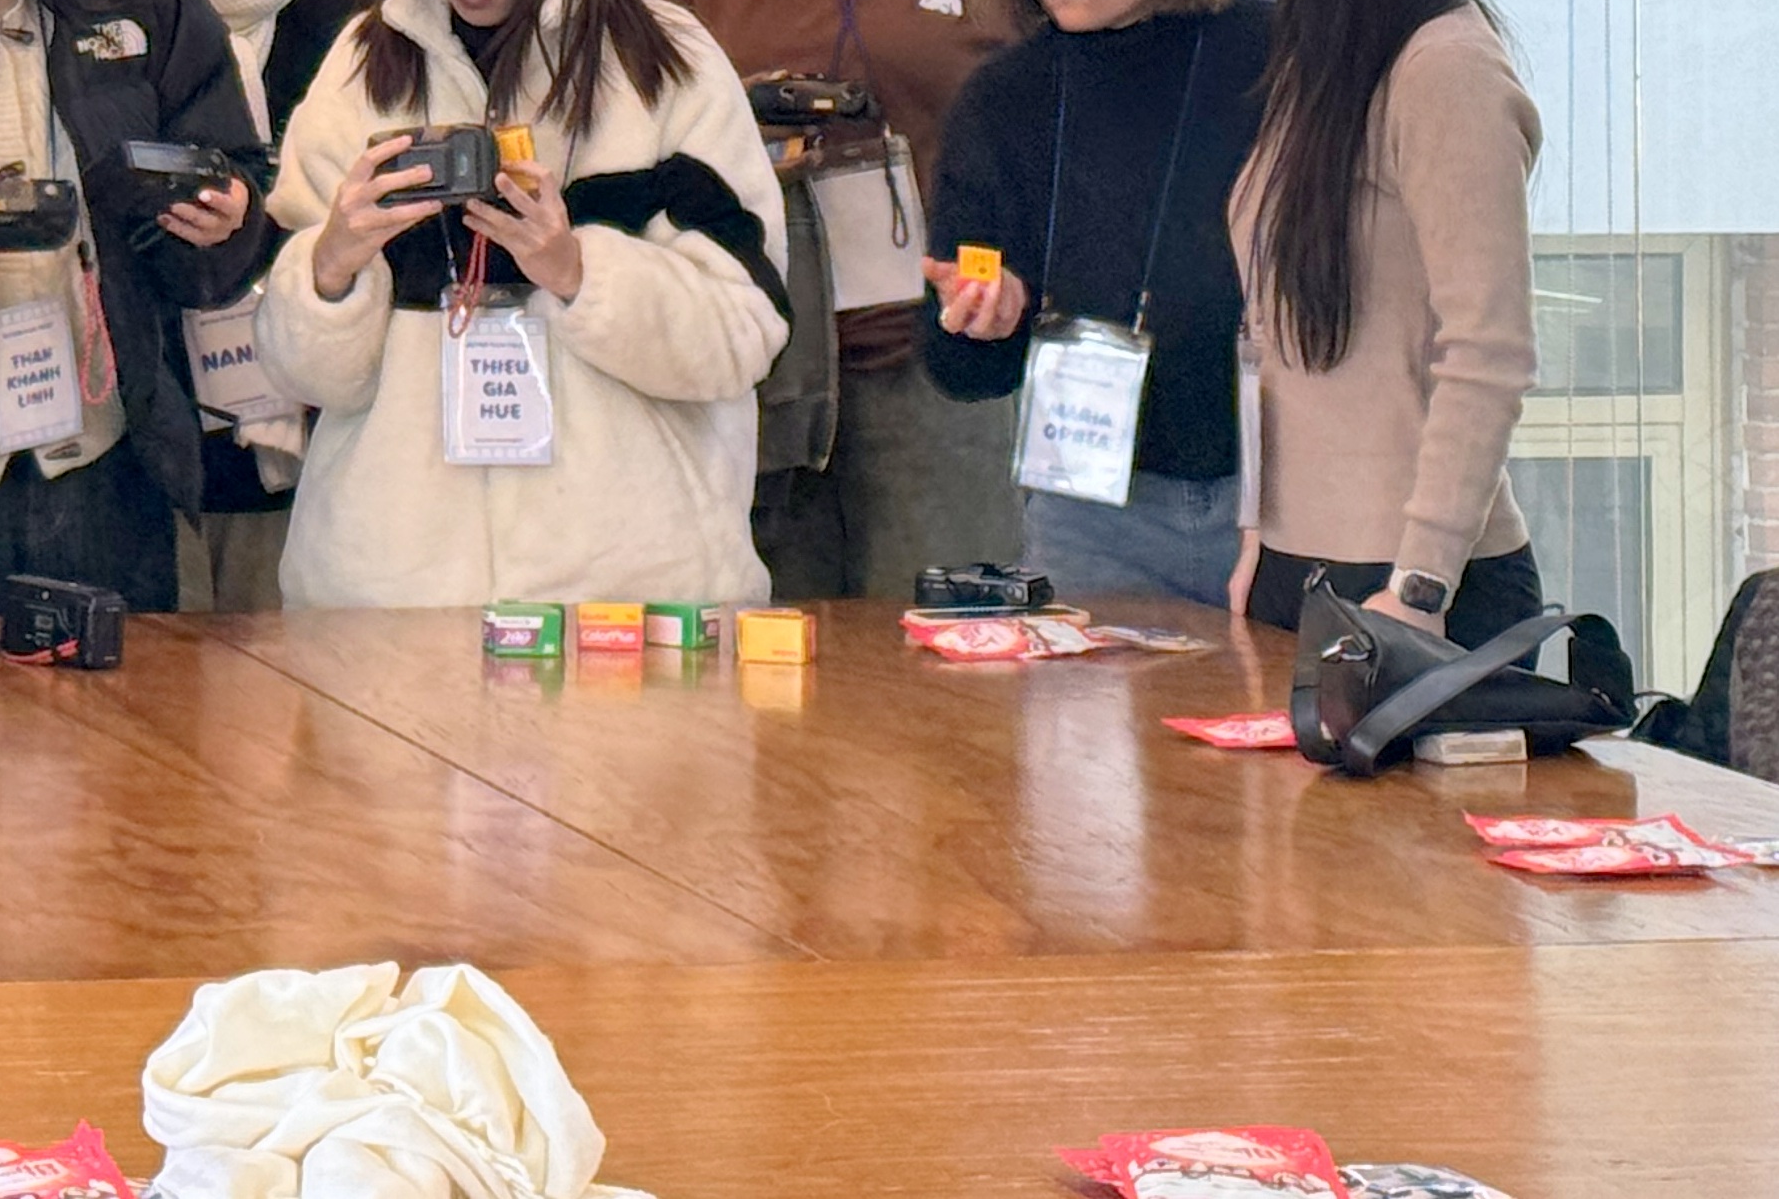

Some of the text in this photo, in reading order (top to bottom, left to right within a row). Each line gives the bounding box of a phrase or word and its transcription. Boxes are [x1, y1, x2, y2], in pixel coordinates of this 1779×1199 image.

[201, 344, 258, 373] NAN
[470, 358, 530, 375] THIEU
[483, 381, 517, 397] GIA
[480, 403, 522, 420] HUE
